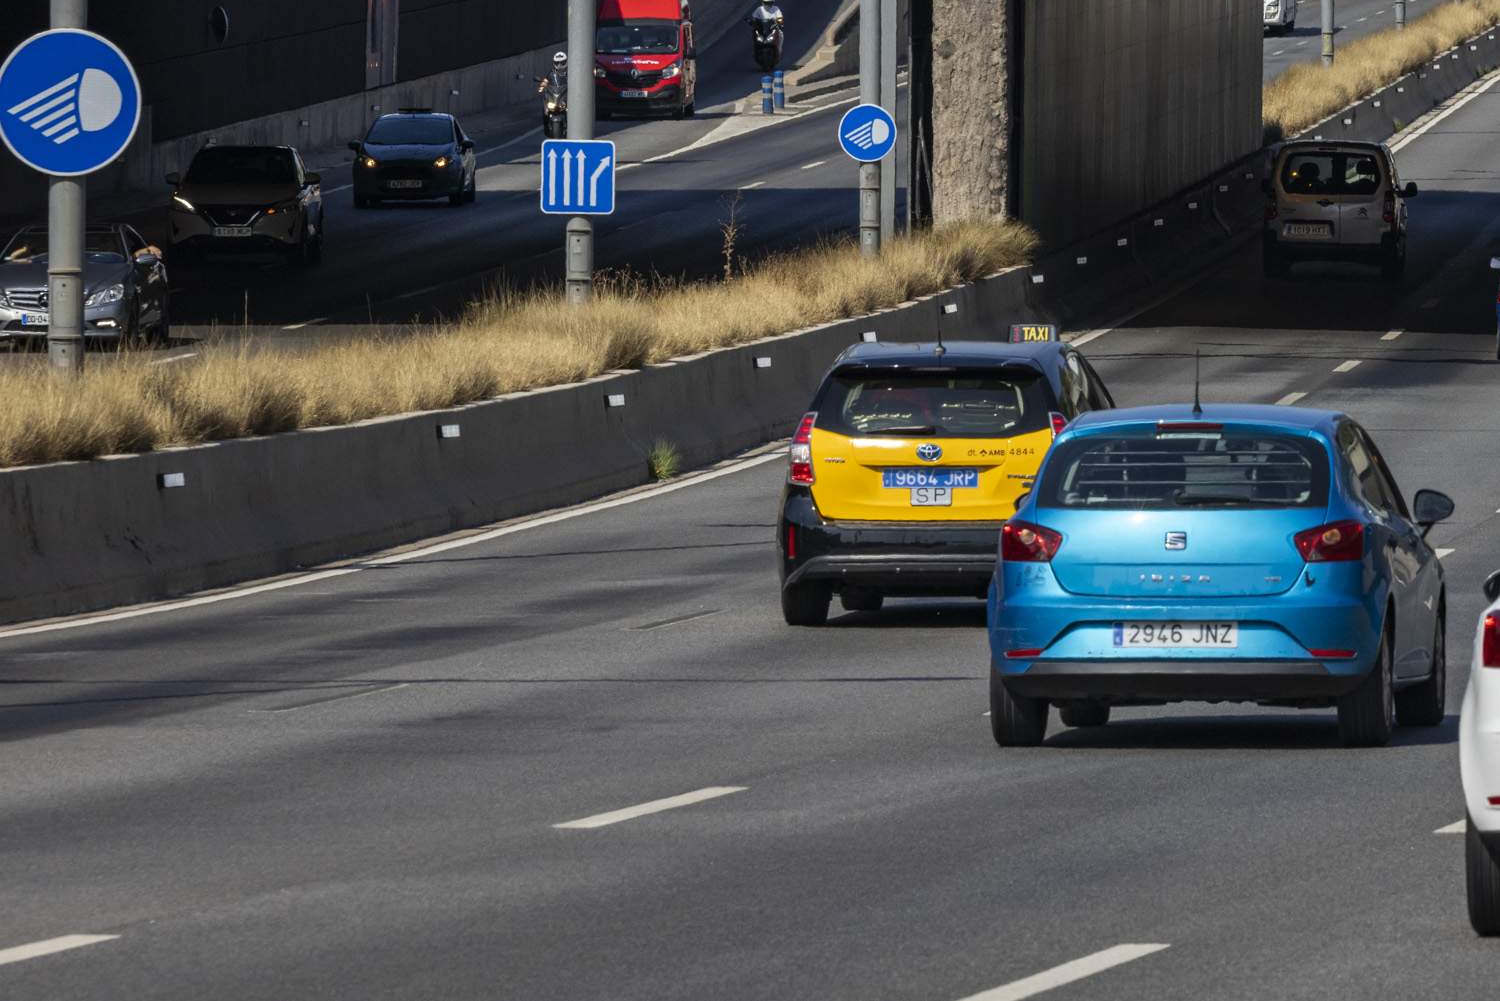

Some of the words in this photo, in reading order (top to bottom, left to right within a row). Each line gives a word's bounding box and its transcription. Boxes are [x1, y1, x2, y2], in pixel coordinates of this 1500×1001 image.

[1022, 326, 1049, 341] TAXI
[1009, 448, 1035, 456] 4844
[895, 470, 938, 486] 9664
[944, 470, 976, 486] JRP
[1129, 624, 1183, 643] 2946
[1192, 624, 1233, 643] JNZ
